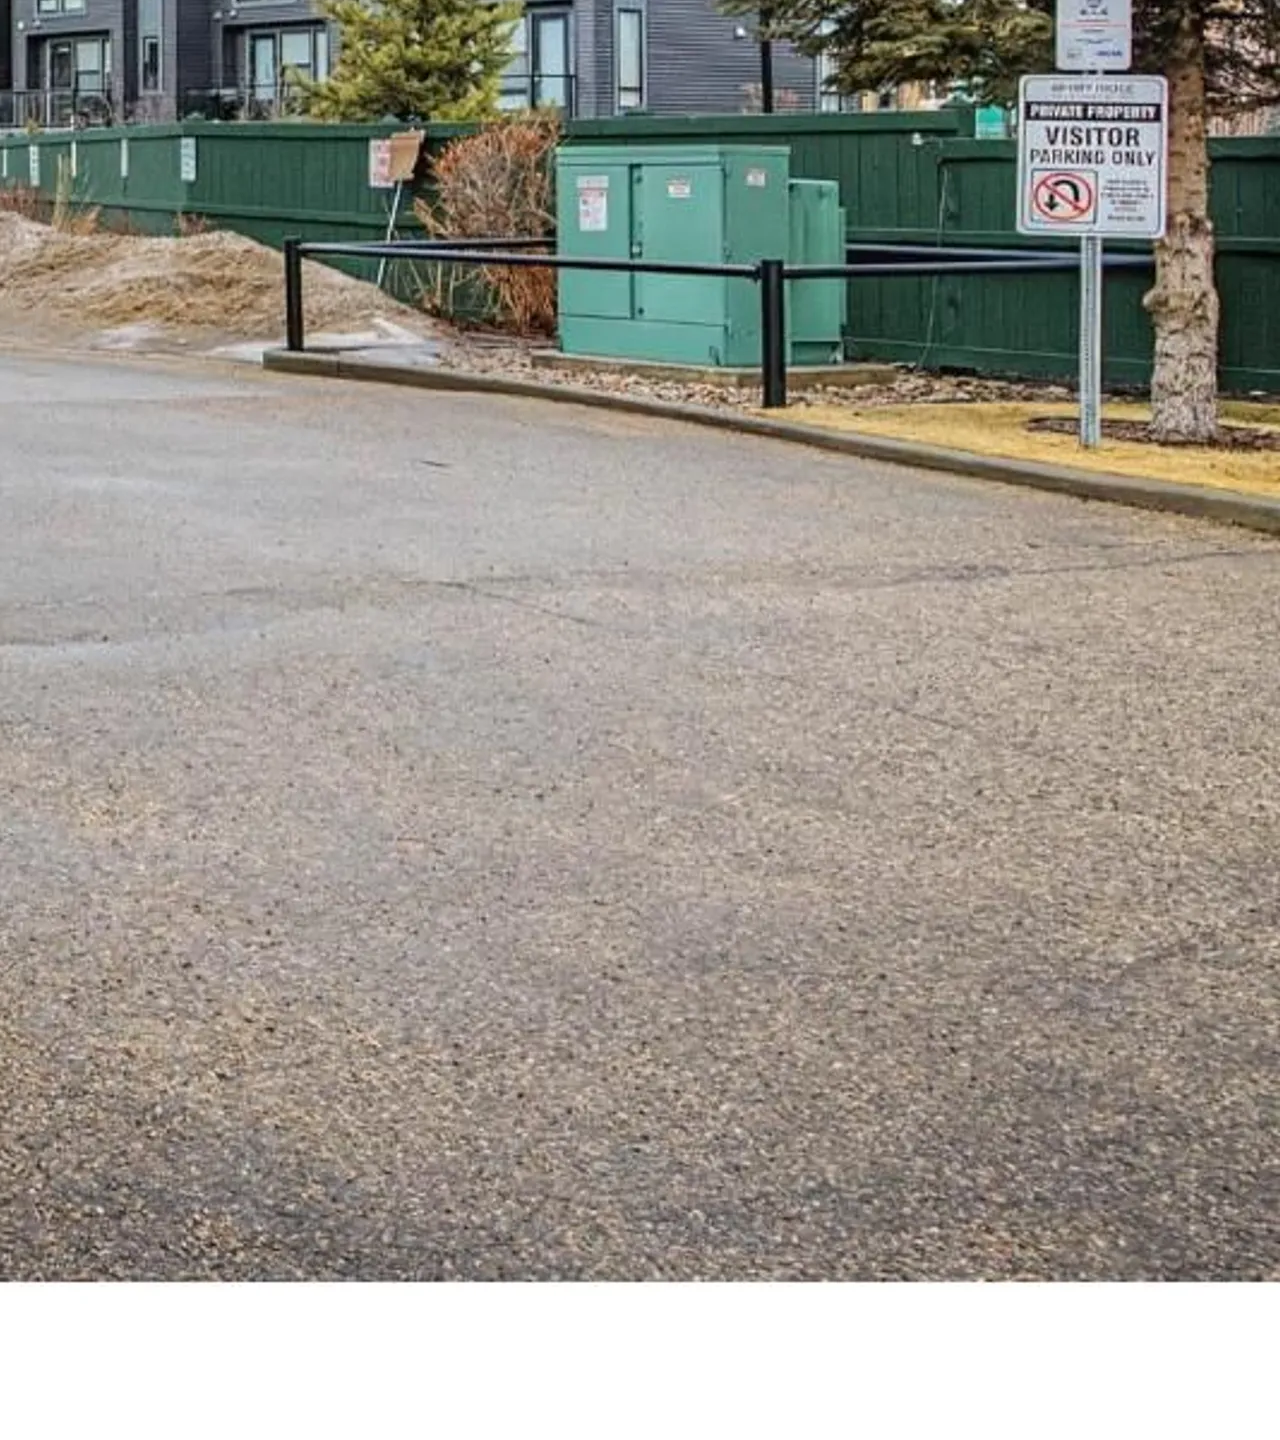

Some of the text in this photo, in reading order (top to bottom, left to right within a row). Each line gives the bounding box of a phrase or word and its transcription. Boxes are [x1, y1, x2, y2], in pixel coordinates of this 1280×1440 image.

[1029, 103, 1157, 120] PRIVATE PROPERTY
[1044, 126, 1140, 147] VISITOR
[1029, 148, 1157, 167] PARKING ONLY
